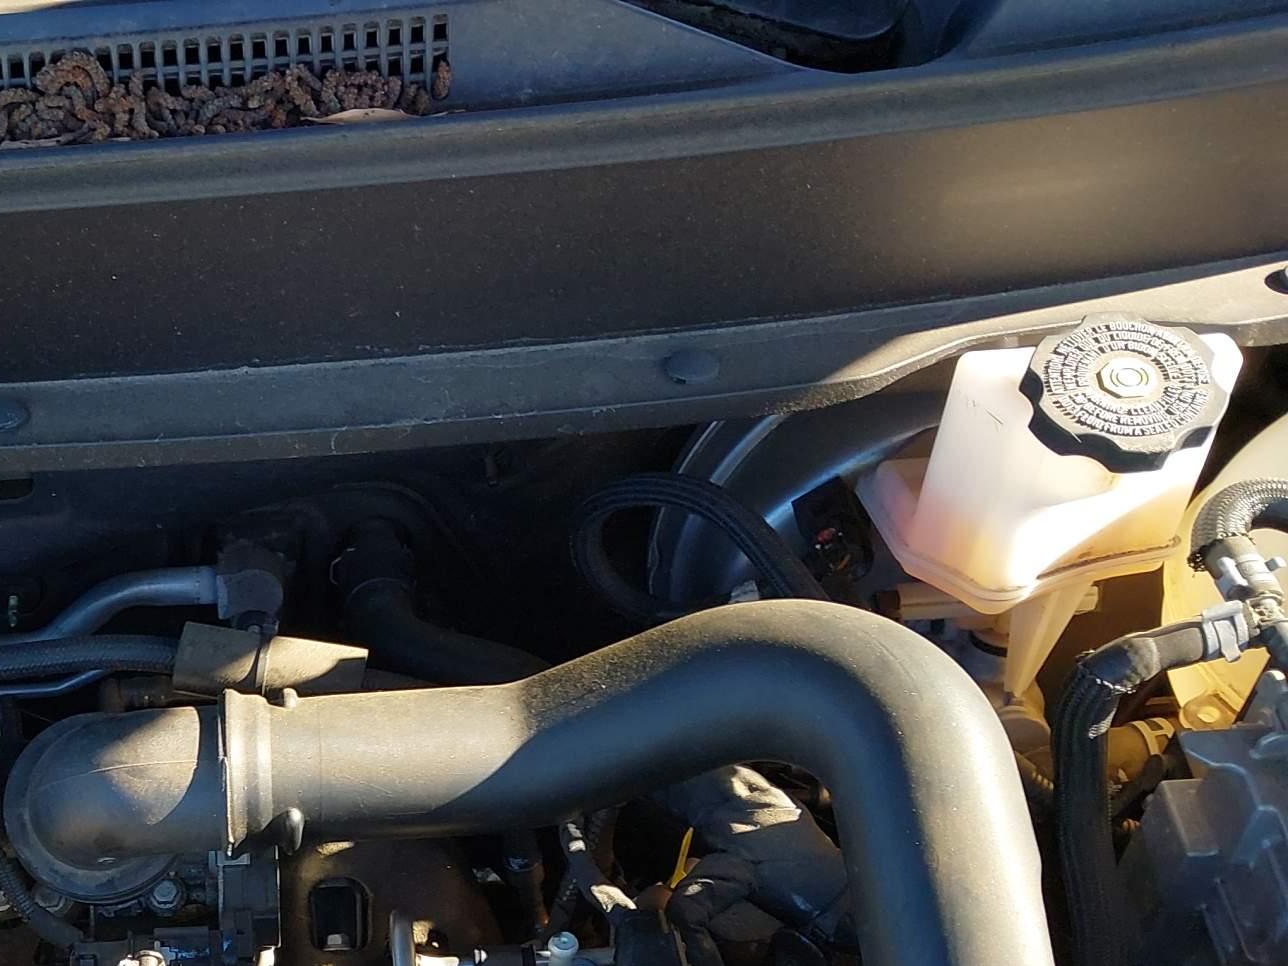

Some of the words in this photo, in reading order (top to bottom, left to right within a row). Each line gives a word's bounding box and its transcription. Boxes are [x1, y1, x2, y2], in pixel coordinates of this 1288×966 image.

[1095, 324, 1107, 334] LE
[1109, 321, 1152, 336] BOUCHON
[1098, 333, 1110, 344] DU
[1083, 401, 1119, 422] BEFORE
[1131, 400, 1165, 416] CLEAN
[1103, 421, 1133, 437] FROM
